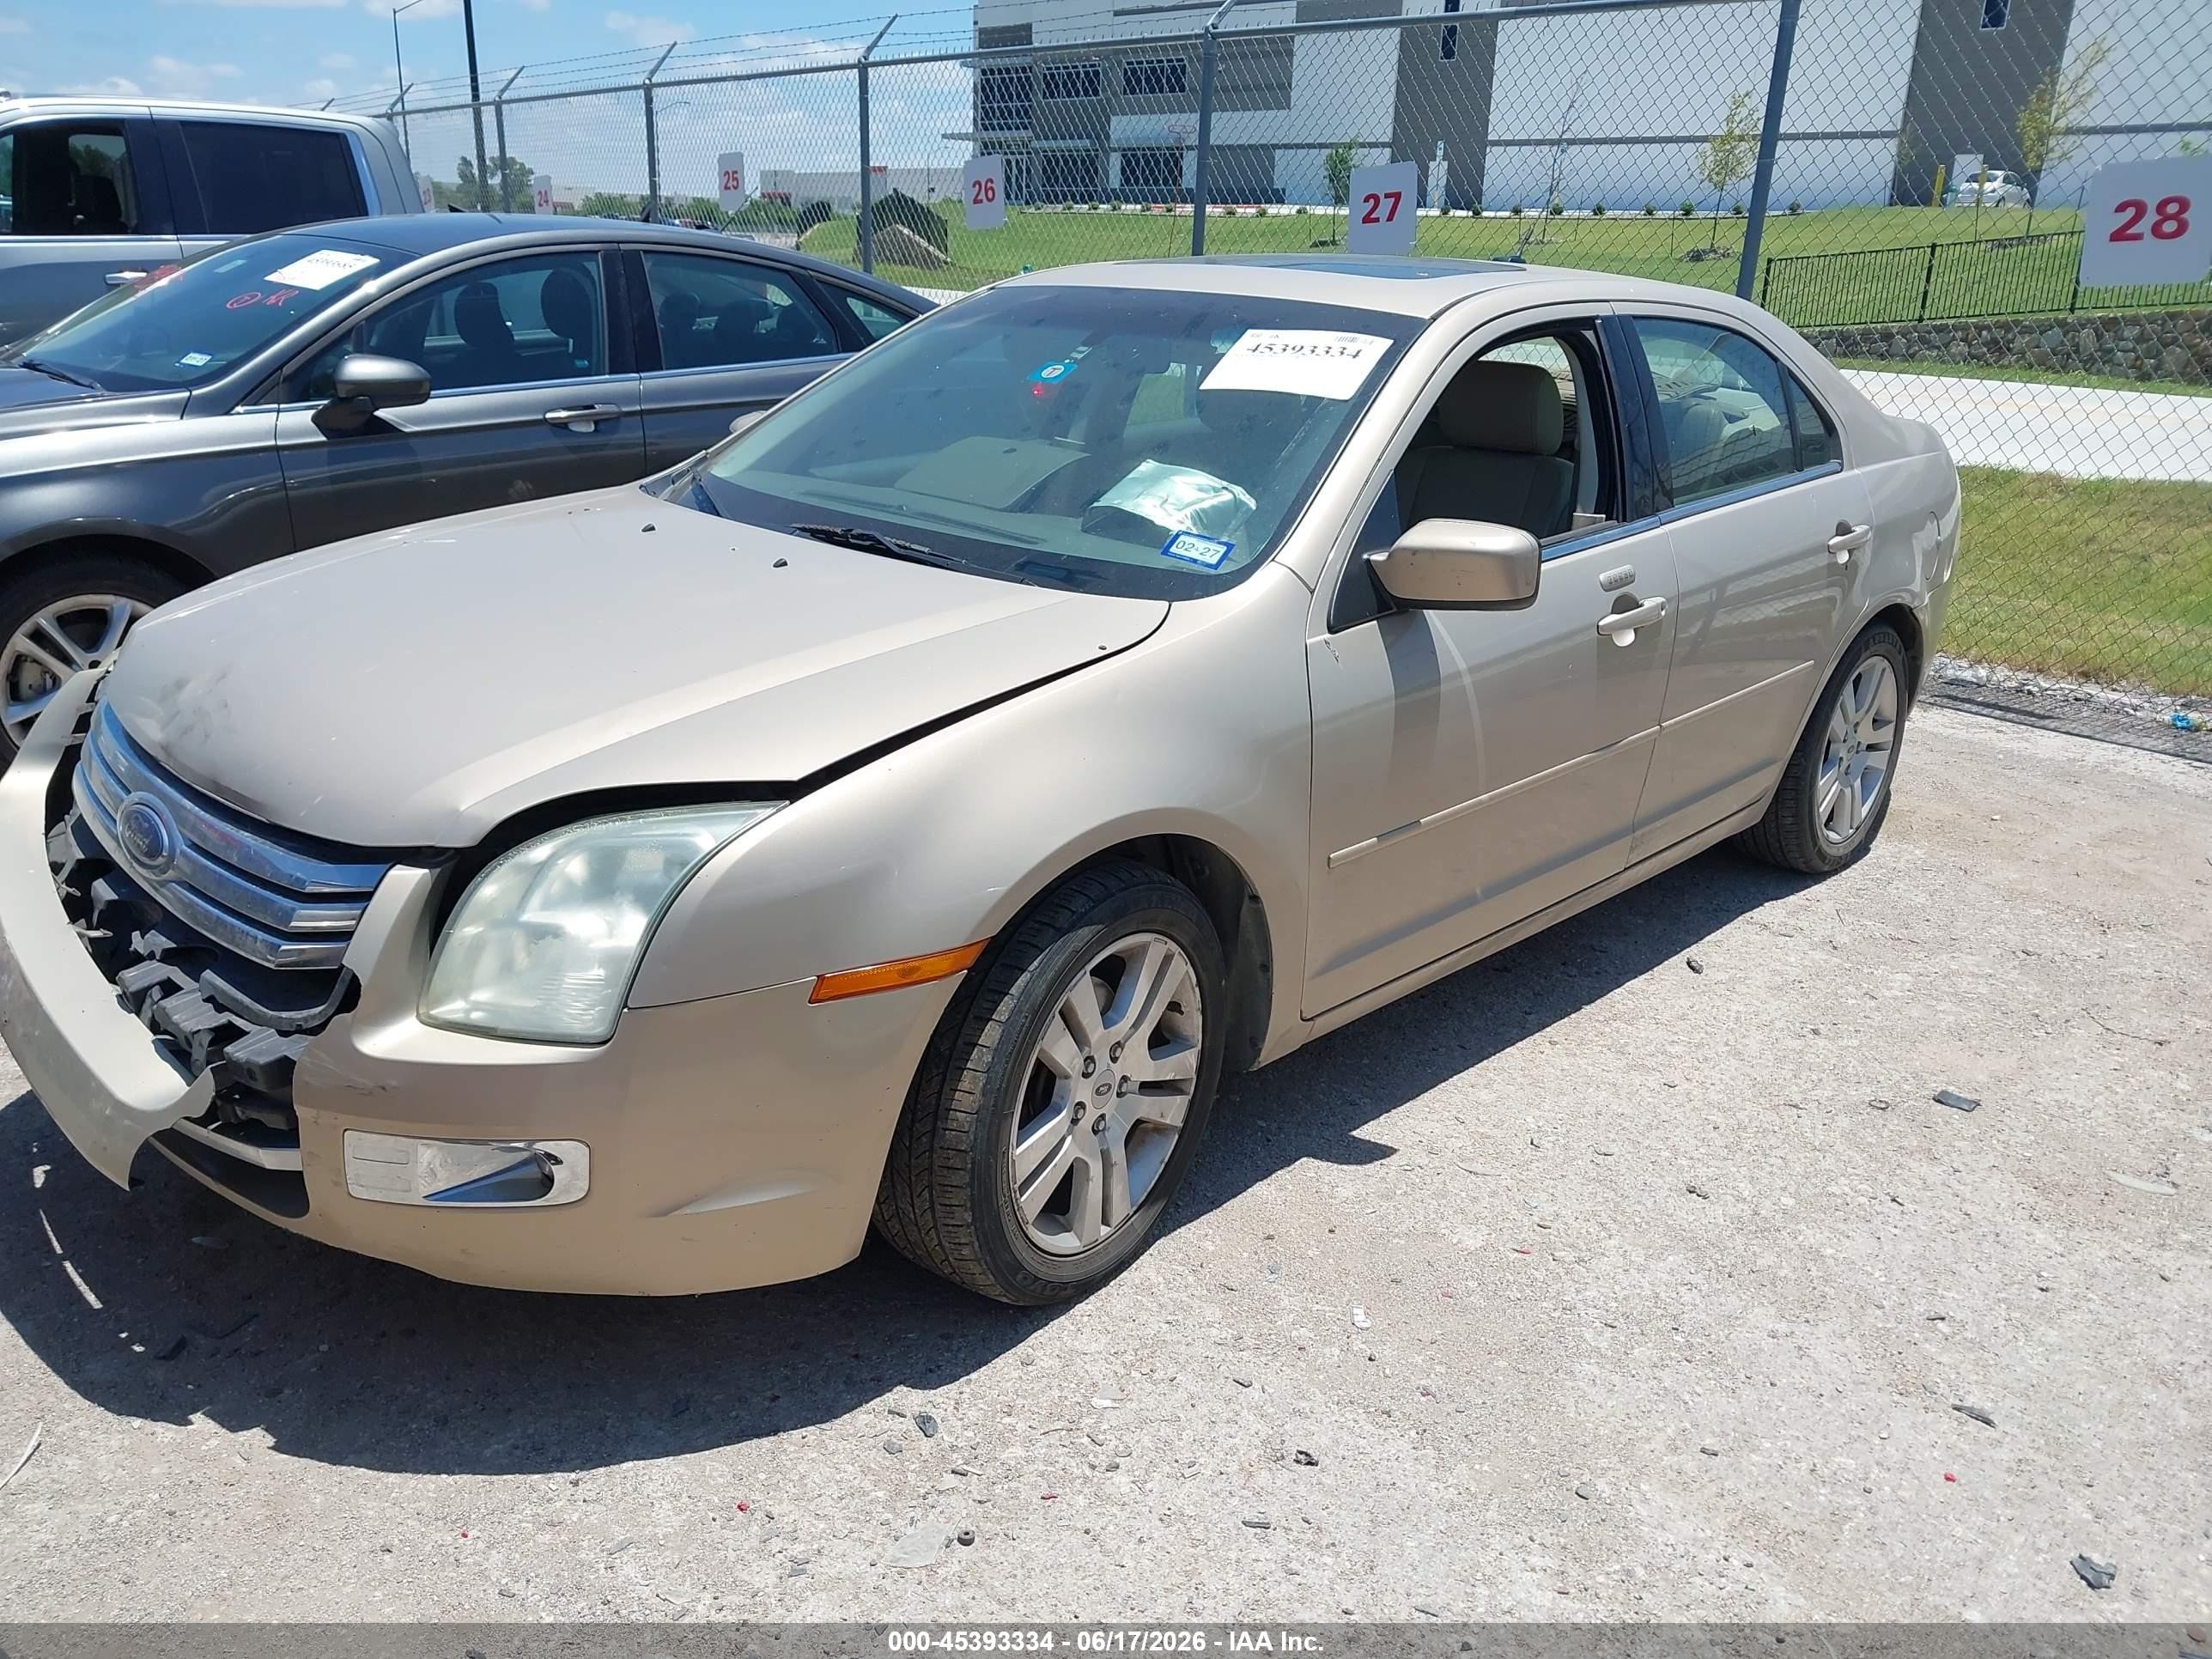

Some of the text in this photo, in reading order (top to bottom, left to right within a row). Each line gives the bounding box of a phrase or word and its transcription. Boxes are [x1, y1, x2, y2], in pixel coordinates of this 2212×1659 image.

[723, 170, 739, 191] 25
[972, 178, 996, 205] 26
[538, 190, 550, 207] 24
[1361, 191, 1402, 225] 27
[2109, 195, 2191, 242] 28
[1246, 343, 1364, 360] 45393334
